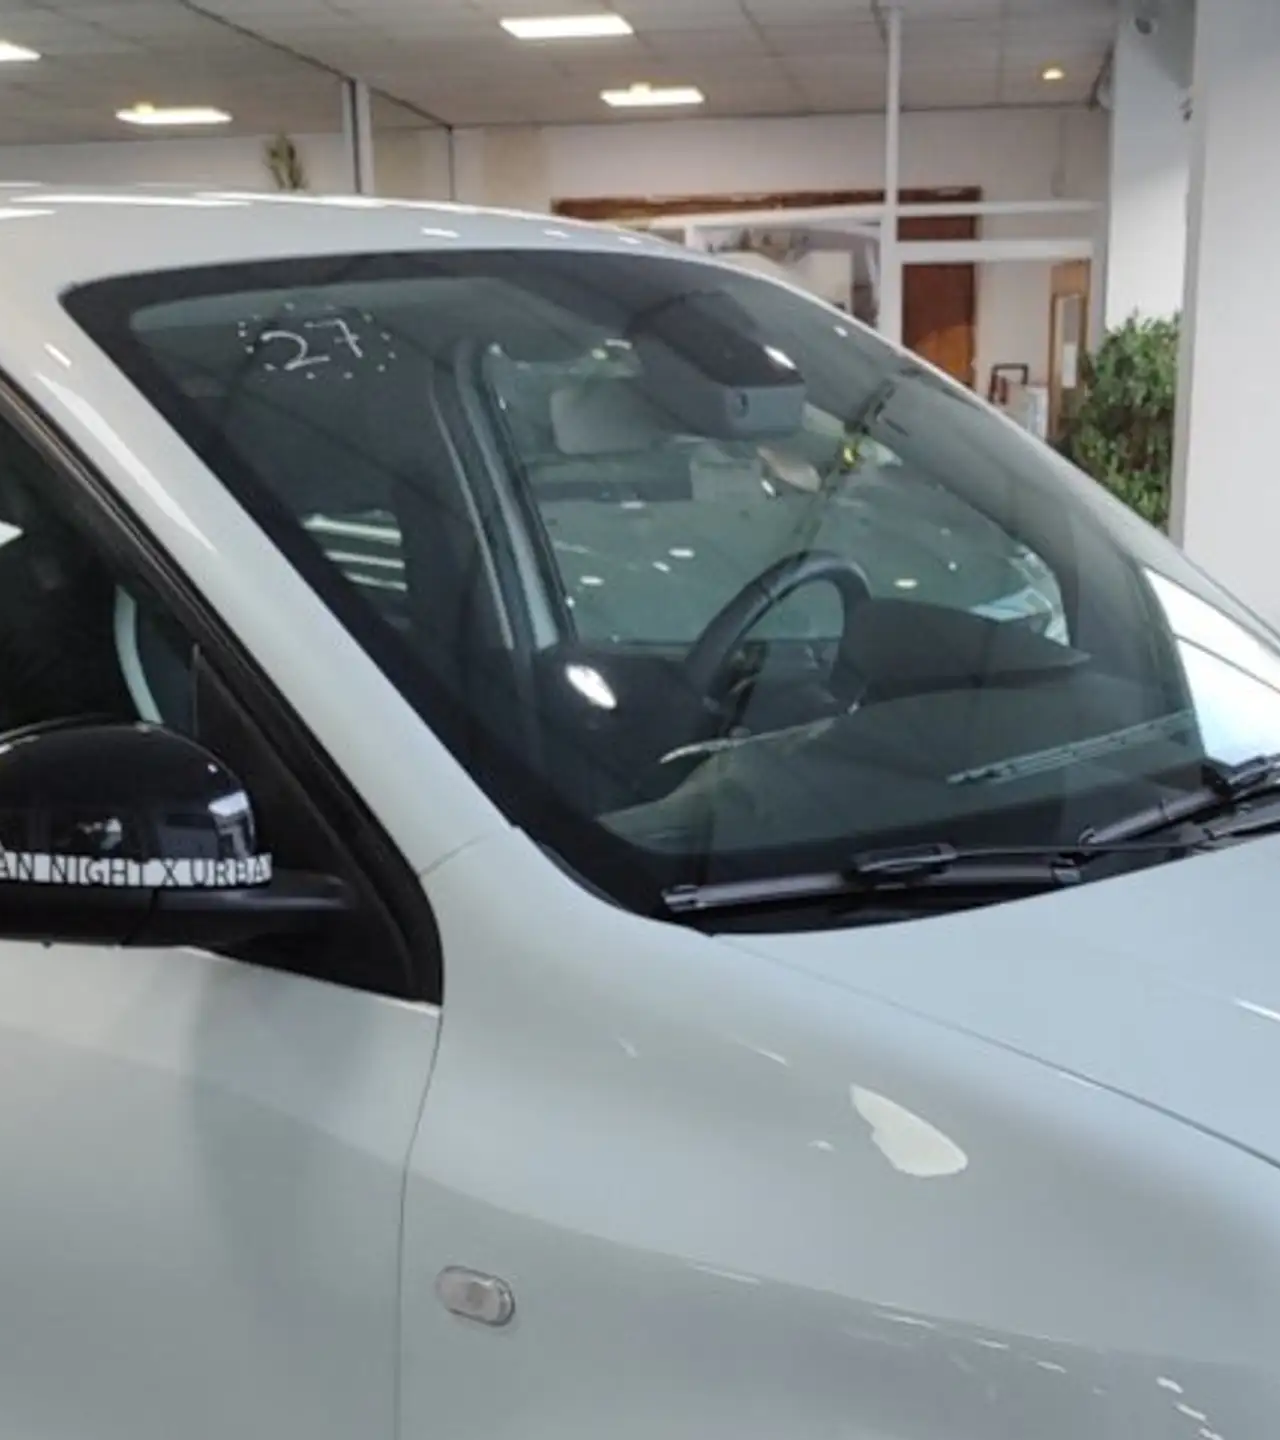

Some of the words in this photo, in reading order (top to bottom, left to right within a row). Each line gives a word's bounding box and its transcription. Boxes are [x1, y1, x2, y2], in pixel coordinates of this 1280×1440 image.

[260, 318, 363, 371] 27
[48, 853, 148, 887] NIGHT
[160, 857, 181, 887] X
